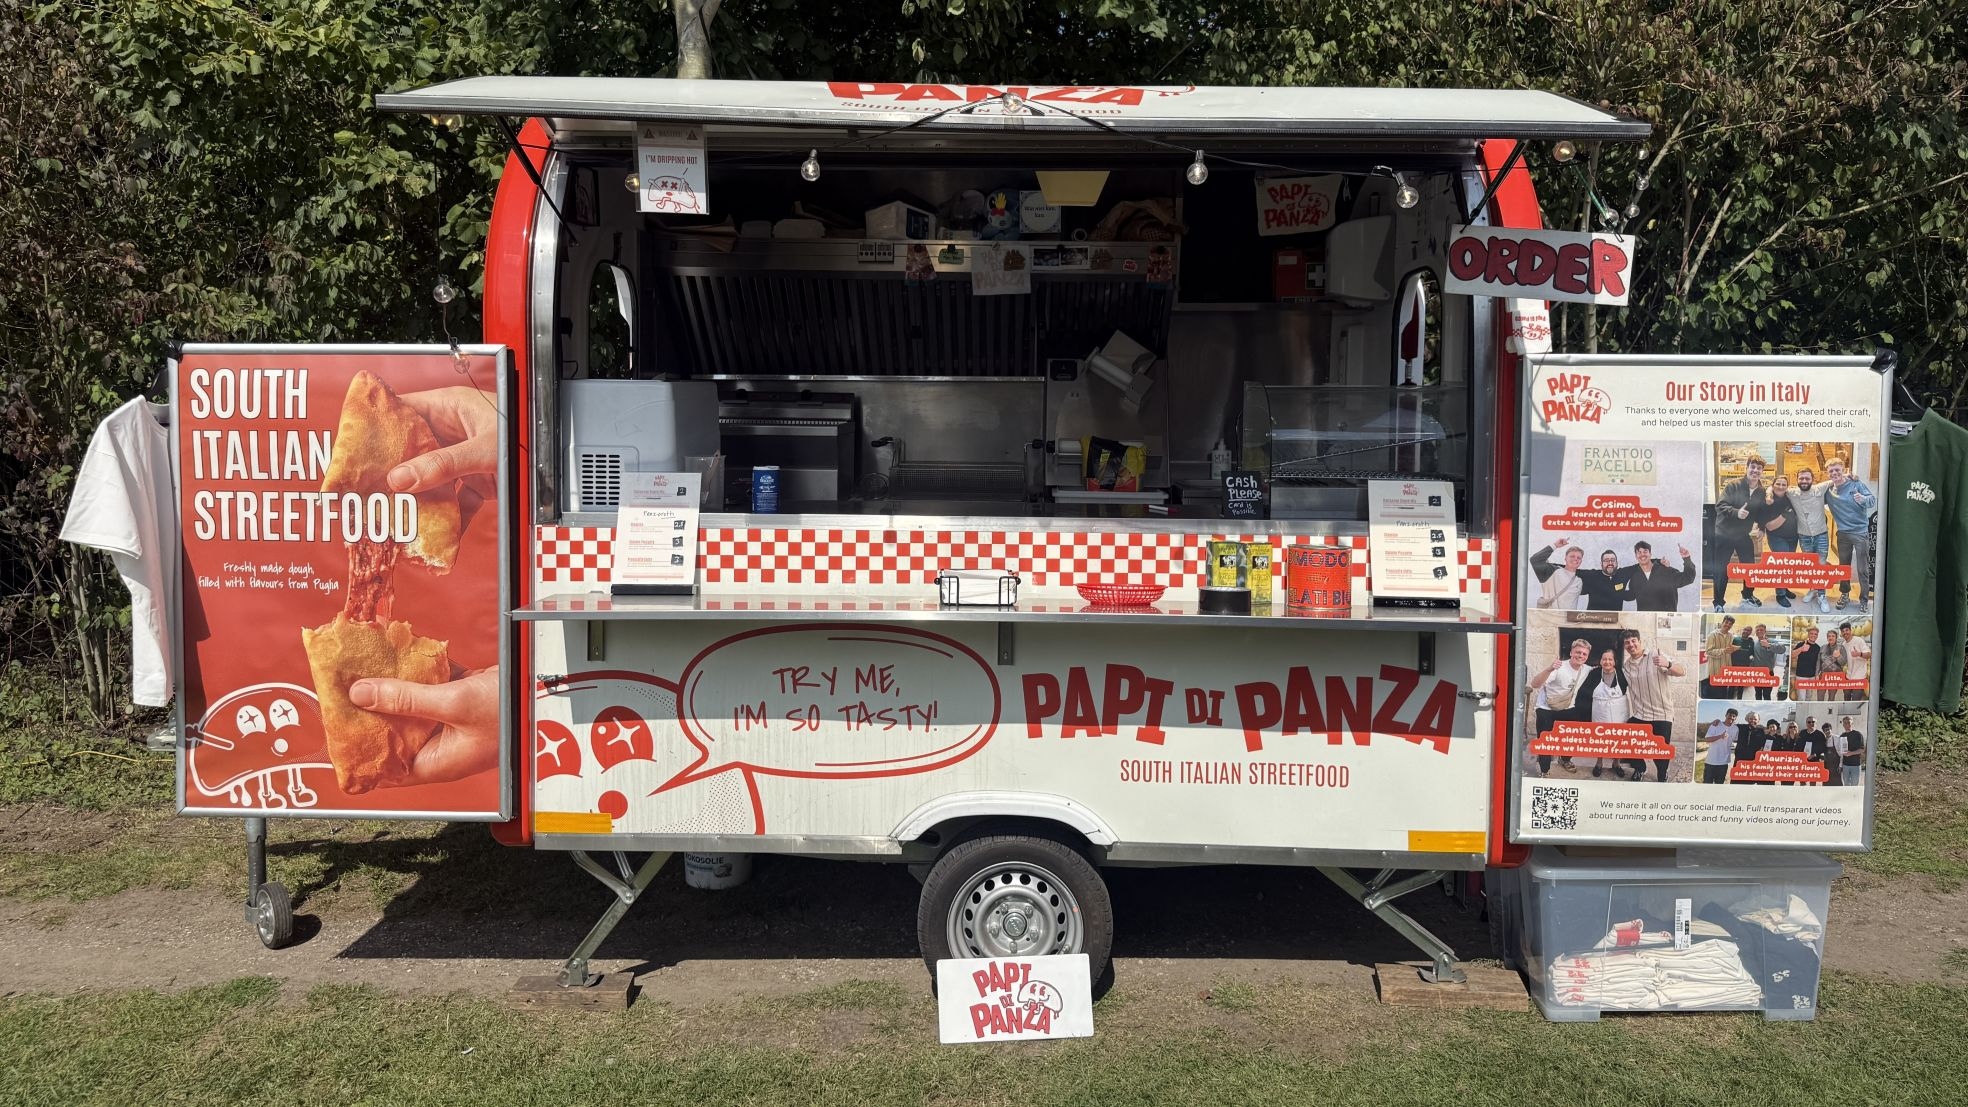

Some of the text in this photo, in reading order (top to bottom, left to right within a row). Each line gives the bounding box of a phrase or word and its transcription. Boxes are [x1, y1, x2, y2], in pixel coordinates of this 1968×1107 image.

[645, 154, 698, 165] I'M DRIPPING HOT
[1267, 183, 1312, 204] PAPI
[1264, 206, 1321, 230] PANZA
[1449, 236, 1628, 297] ORDER
[1547, 372, 1591, 396] PAPI
[189, 368, 308, 420] SOUTH
[1565, 395, 1575, 404] DI
[1665, 380, 1810, 405] Our Story in Italy
[1542, 399, 1601, 424] PANZA
[1625, 406, 1656, 415] Thanks
[1658, 407, 1667, 415] to
[1669, 408, 1710, 416] everyone
[1712, 407, 1731, 415] who
[1732, 407, 1777, 415] welcomed
[1795, 408, 1825, 416] shared
[1827, 408, 1847, 416] their
[1849, 408, 1871, 417] craft,
[1641, 418, 1657, 427] and
[1659, 419, 1688, 428] helped
[1703, 419, 1734, 427] master
[1736, 419, 1752, 427] this
[1754, 420, 1785, 429] special
[1787, 420, 1833, 428] streetfood
[1835, 420, 1855, 428] dish.
[192, 430, 332, 481] ITALIAN
[1584, 447, 1653, 459] FRANTOIO
[1584, 459, 1653, 473] PACELLO
[1911, 481, 1930, 490] PAPI
[1906, 489, 1931, 504] PANZA
[1592, 498, 1635, 510] Cosimo,
[193, 490, 419, 543] STREETFOOD
[1571, 510, 1603, 518] learned
[1547, 519, 1571, 527] extra
[1573, 519, 1597, 528] virgin
[1599, 519, 1617, 527] olive
[1643, 520, 1654, 528] his
[1656, 520, 1678, 528] farm
[1766, 555, 1815, 567] Antonio,
[224, 561, 314, 578] Freshly made dough,
[1748, 568, 1794, 576] panzerotti
[198, 576, 339, 595] filled with flavours from Puglia
[1750, 576, 1782, 584] showed
[1723, 668, 1766, 678] Francesco,
[772, 664, 900, 697] TRY ME,
[1756, 677, 1777, 685] fillings
[1021, 663, 1458, 755] PAPI DI PANZA
[733, 700, 939, 733] I'M SO TASTY!
[1558, 724, 1648, 738] Santa Caterina,
[1545, 735, 1658, 748] the oldest bakery in Puglia,
[1534, 743, 1561, 752] where
[1576, 745, 1609, 753] learned
[1611, 746, 1632, 755] from
[1634, 747, 1671, 755] tradition
[1759, 753, 1803, 764] Maurizio,
[1120, 759, 1350, 789] SOUTH ITALIAN STREETFOOD
[1752, 763, 1774, 772] family
[1801, 764, 1820, 772] flour,
[1600, 800, 1614, 809] We
[1616, 801, 1640, 809] share
[1641, 801, 1647, 809] it
[1649, 802, 1659, 810] all
[1689, 803, 1714, 811] social
[1716, 804, 1744, 812] media.
[1746, 804, 1761, 812] Full
[1763, 805, 1812, 814] transparant
[1814, 806, 1842, 814] videos
[1589, 812, 1613, 820] about
[1615, 813, 1647, 822] running
[1656, 813, 1676, 821] food
[1678, 814, 1699, 822] truck
[1701, 814, 1718, 822] and
[1719, 815, 1743, 825] funny
[1745, 816, 1774, 824] videos
[1775, 816, 1799, 826] along
[1816, 818, 1851, 827] journey.
[972, 960, 1032, 998] PAPI
[999, 993, 1015, 1009] DI
[969, 1002, 1051, 1039] PANZA
